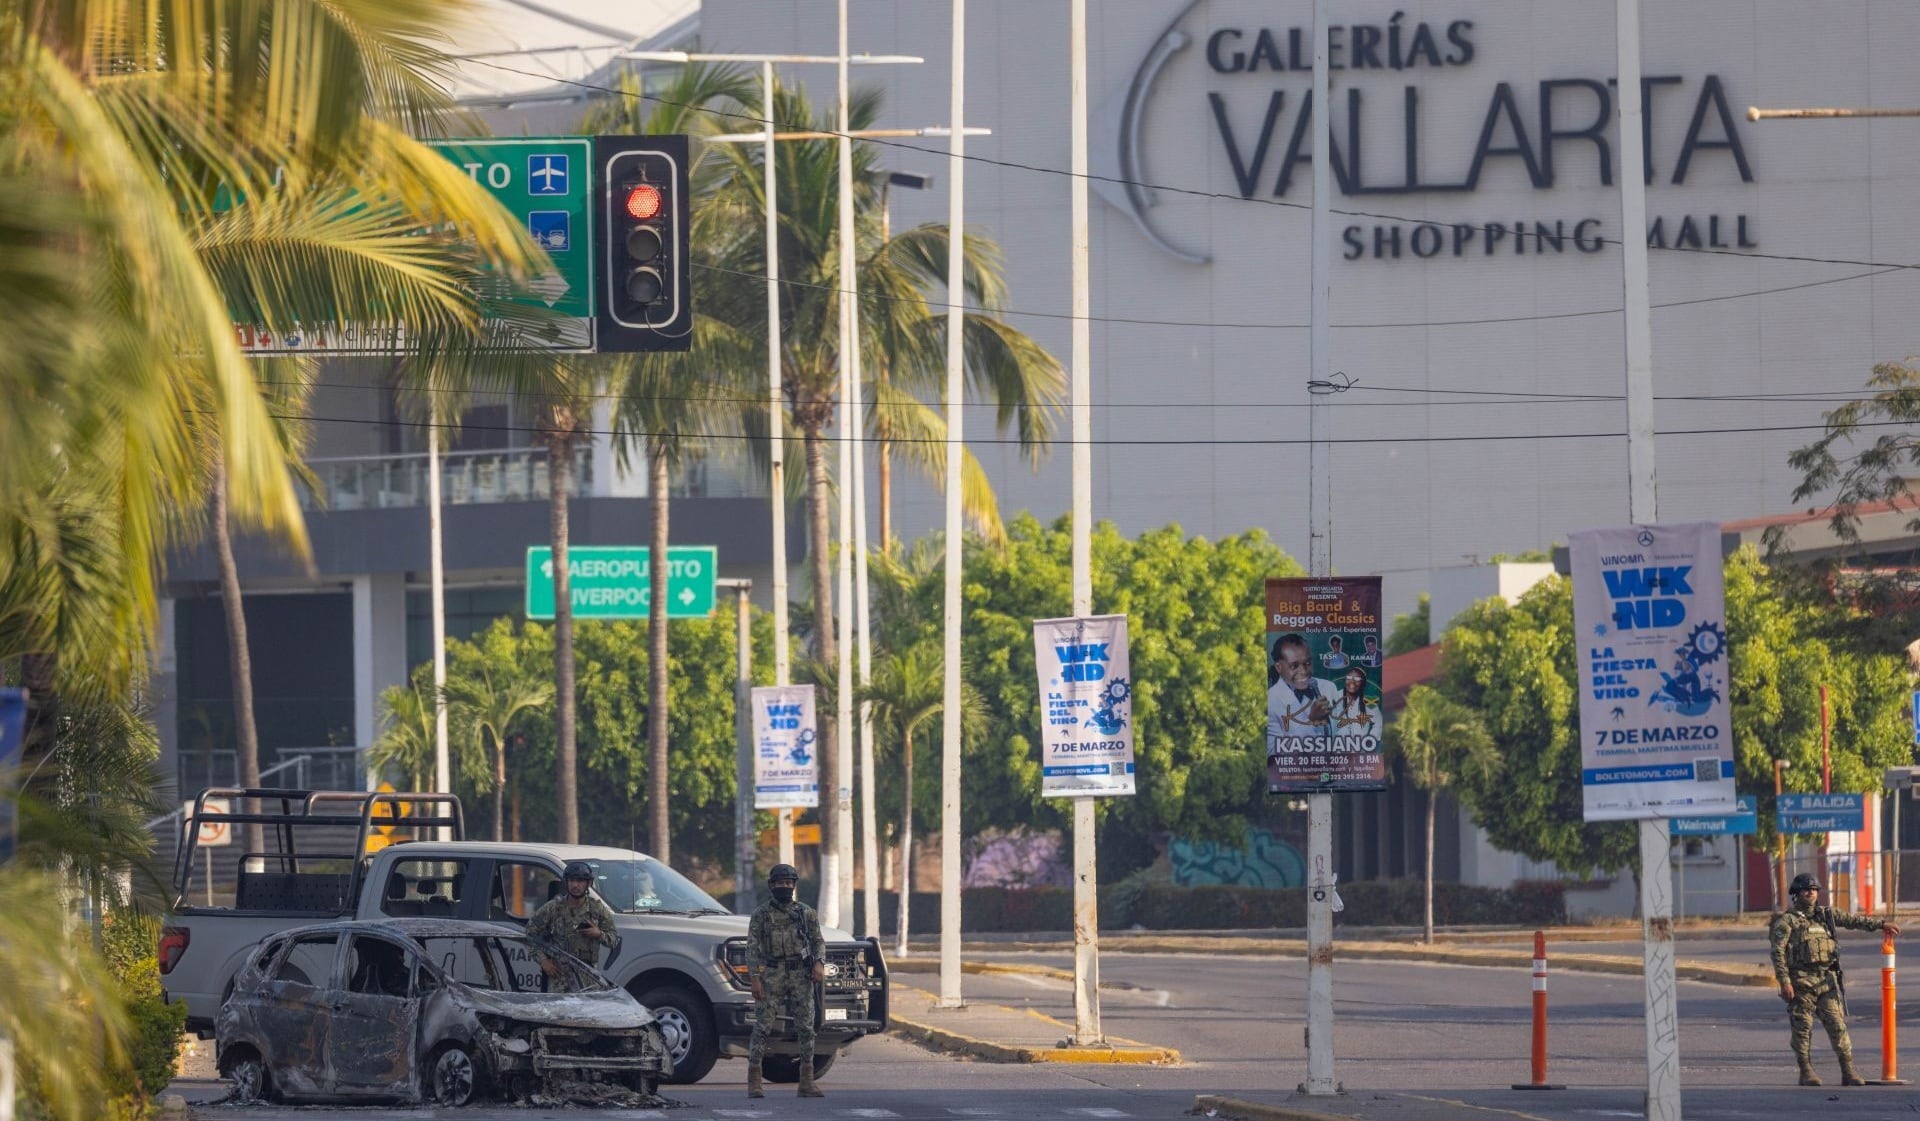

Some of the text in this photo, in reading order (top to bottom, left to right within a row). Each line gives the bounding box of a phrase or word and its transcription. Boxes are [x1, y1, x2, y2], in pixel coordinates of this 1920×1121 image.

[1206, 12, 1476, 73] GALERÍAS
[1207, 74, 1754, 199] VALLARTA
[1342, 218, 1605, 261] SHOPPING
[568, 559, 702, 578] AEROPURTO
[1279, 600, 1361, 614] Big Band &
[1273, 613, 1375, 627] Reggae Classics
[1591, 647, 1615, 660] LA
[1591, 658, 1657, 673] FIESTA
[1592, 674, 1628, 686] DEL
[1048, 692, 1062, 700] LA
[1593, 687, 1640, 700] VINO
[1048, 700, 1088, 708] FIESTA
[1050, 717, 1079, 725] VINO
[1595, 725, 1719, 746] 7 DE MARZO
[1051, 740, 1125, 753] 7 DE MARZO
[1276, 736, 1377, 753] KASSIANO
[1298, 757, 1309, 765] 20
[1330, 756, 1349, 764] 2026
[1595, 768, 1689, 782] BOLETOMOVIL.COM
[1801, 796, 1855, 809] SALIDA
[1676, 819, 1726, 831] Walmart
